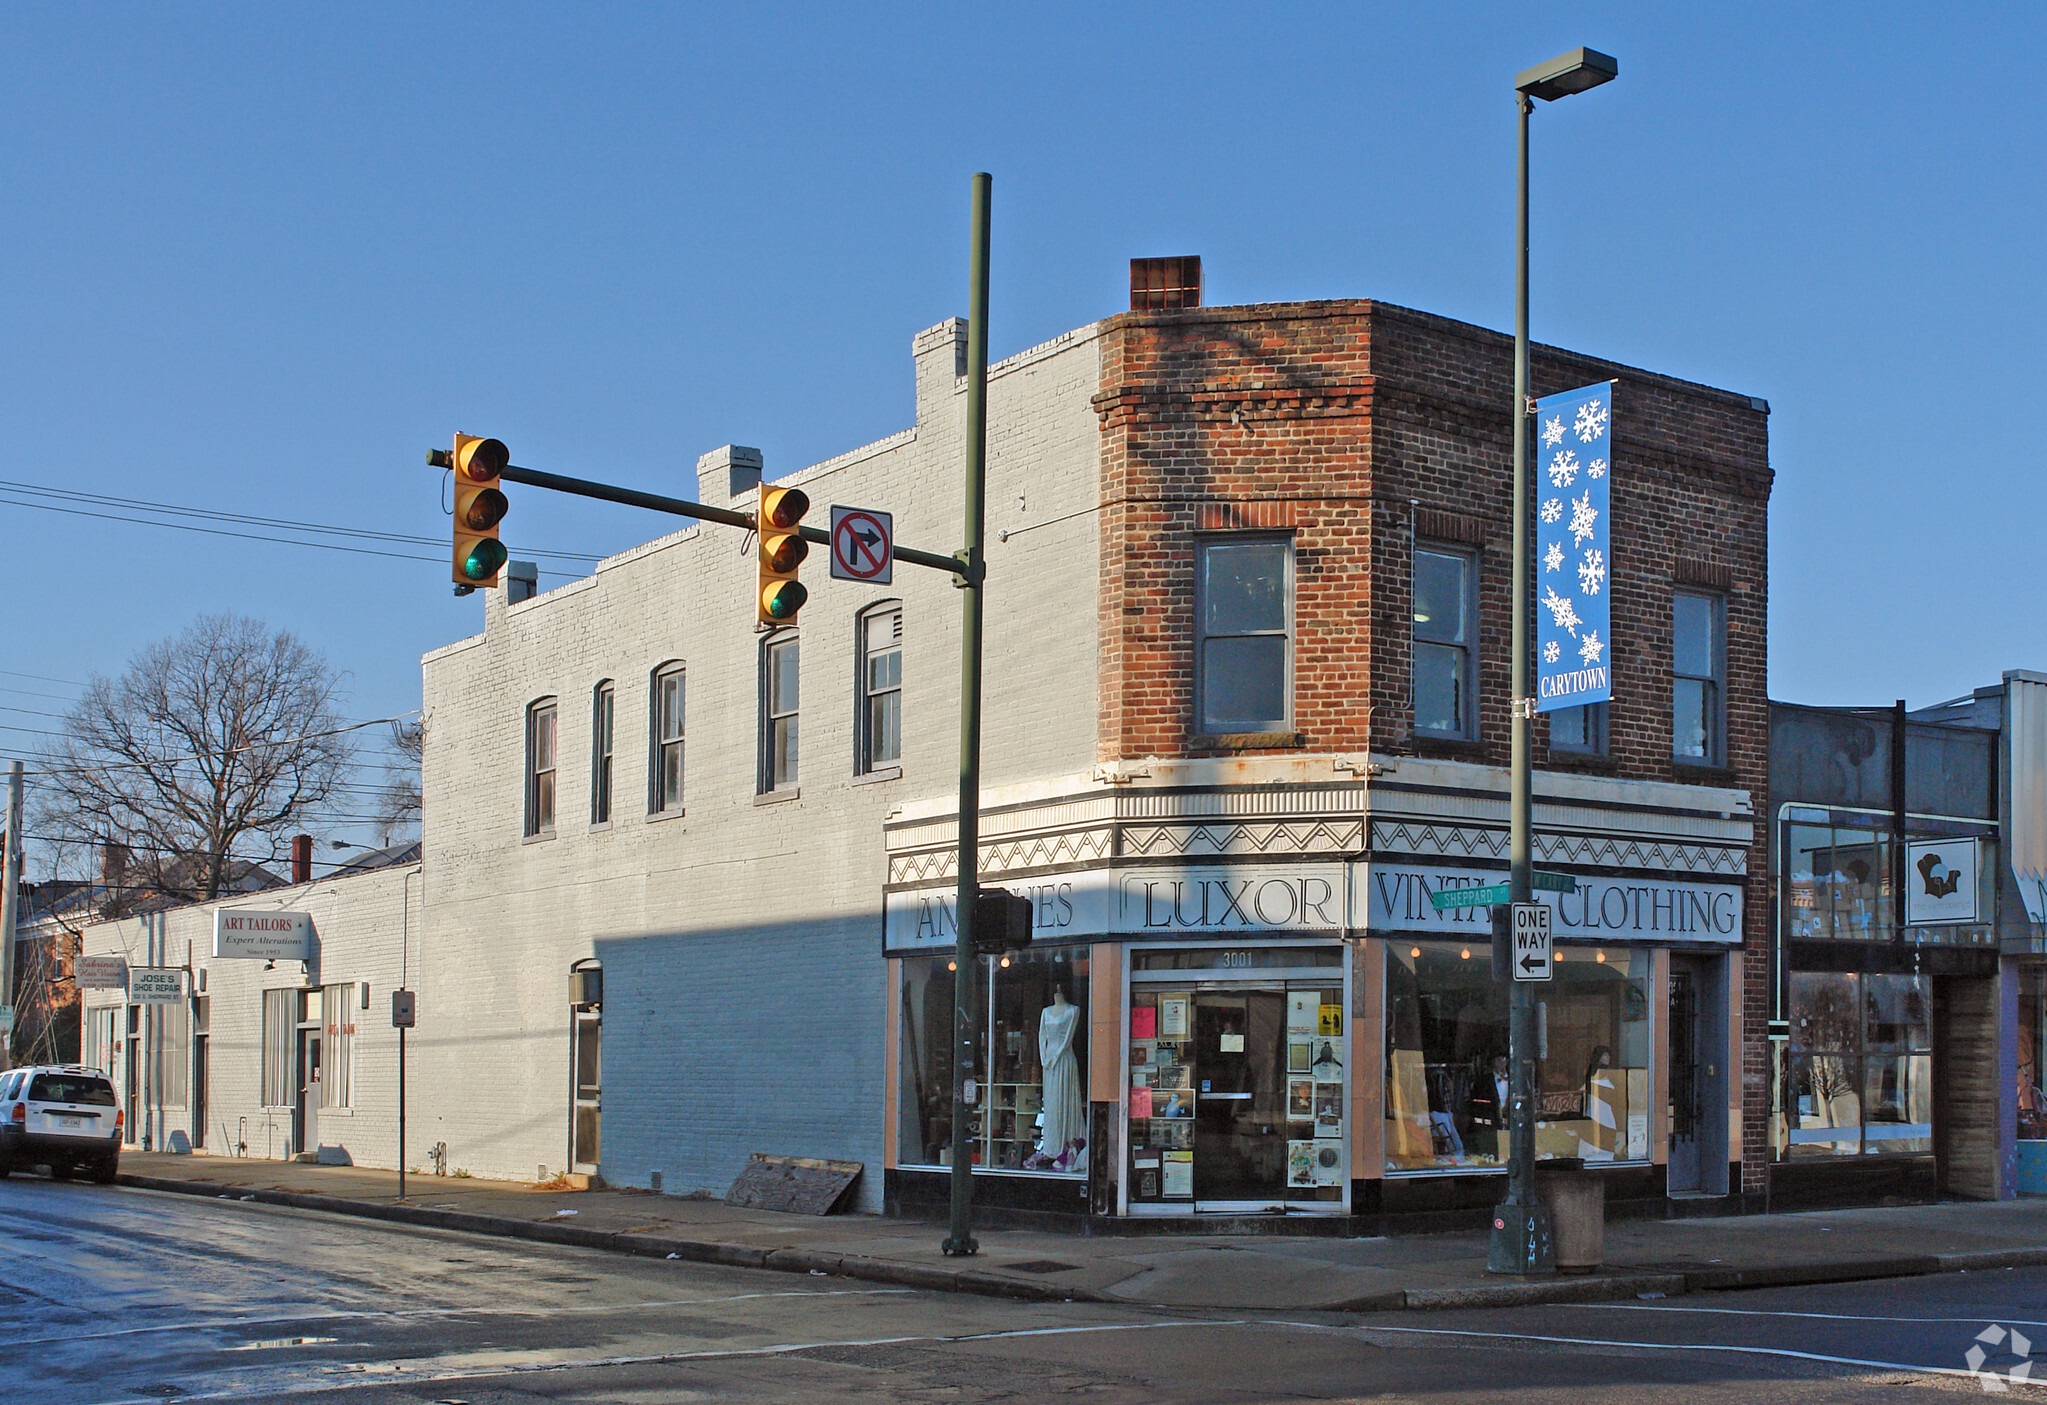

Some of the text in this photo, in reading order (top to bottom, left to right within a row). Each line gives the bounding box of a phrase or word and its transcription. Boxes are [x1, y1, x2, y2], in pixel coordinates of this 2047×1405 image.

[1541, 666, 1606, 698] CARYTOWN
[1143, 878, 1336, 928] LUXOR
[1444, 889, 1493, 907] SHEPPARD
[1558, 884, 1736, 934] CLOTHING
[223, 917, 292, 932] ART TAILORS
[1517, 910, 1547, 928] ONE
[225, 935, 302, 946] Expert Alterations
[1517, 932, 1547, 949] WAY
[1223, 951, 1252, 968] 3001
[140, 974, 175, 983] JOSE'S
[133, 983, 181, 993] SHOE REPAIR
